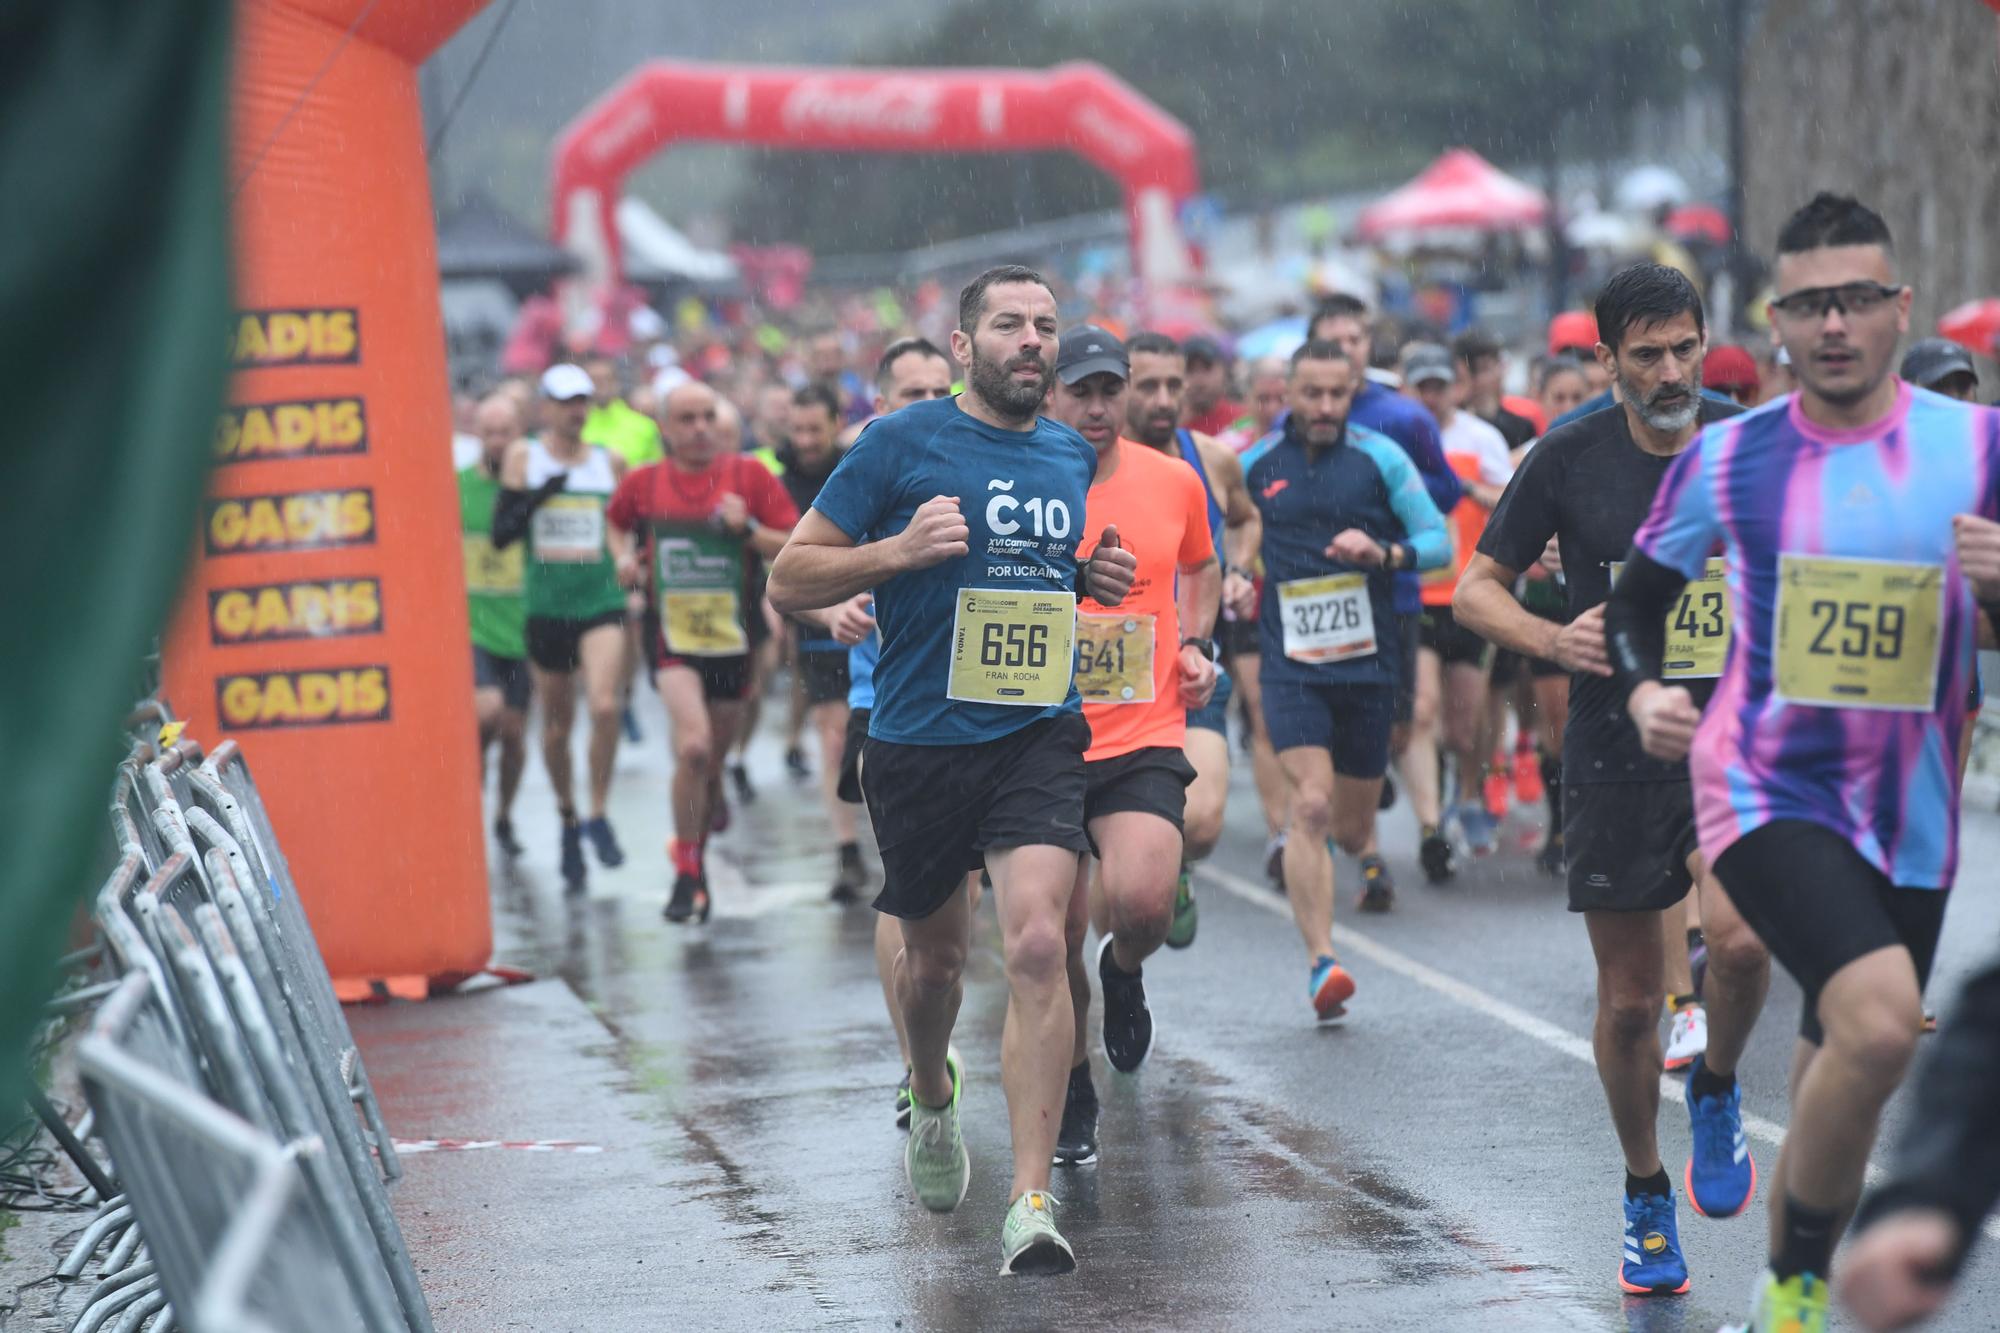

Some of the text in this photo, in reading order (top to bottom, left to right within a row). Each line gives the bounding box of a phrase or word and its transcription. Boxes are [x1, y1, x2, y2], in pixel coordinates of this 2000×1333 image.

[233, 311, 356, 360] ADIS
[211, 491, 372, 547] GADIS
[987, 538, 1039, 548] XVI Carreira
[987, 546, 1022, 555] Popular
[987, 566, 1011, 577] POR
[214, 580, 379, 636] GADIS
[1293, 598, 1361, 636] 3226
[957, 626, 966, 654] TANDA
[981, 623, 1048, 667] 656
[1808, 599, 1905, 660] 259
[1077, 637, 1124, 673] 641
[1668, 644, 1694, 653] FRAN
[985, 671, 1040, 681] FRAN ROCHA
[222, 668, 387, 724] GADIS
